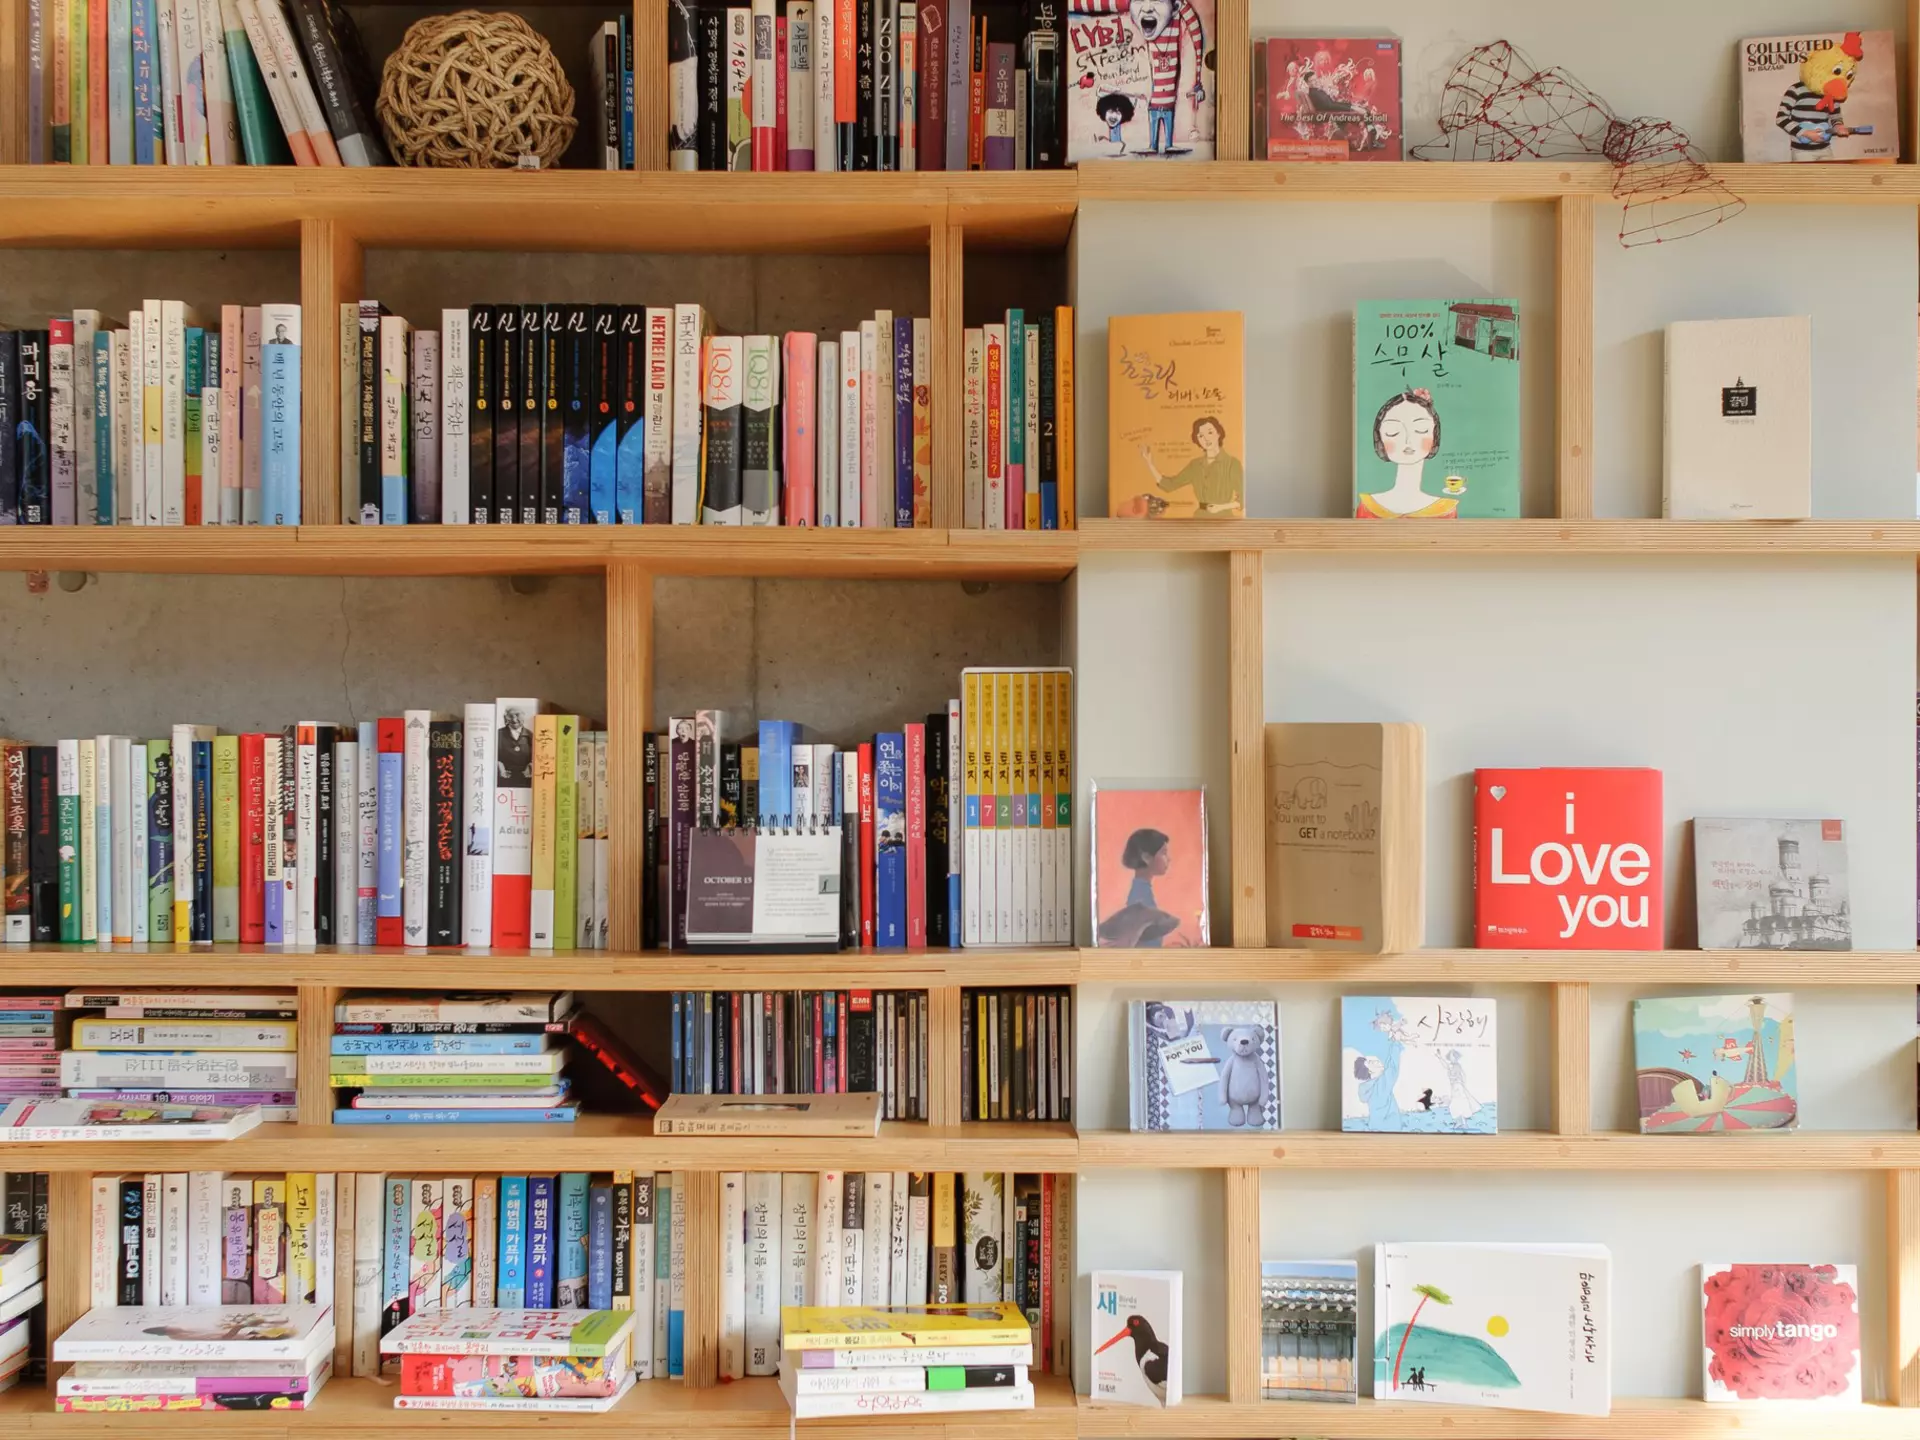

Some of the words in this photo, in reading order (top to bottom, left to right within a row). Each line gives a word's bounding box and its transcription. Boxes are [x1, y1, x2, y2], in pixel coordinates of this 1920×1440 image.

[880, 18, 892, 64] ZOO
[1747, 38, 1834, 55] COLLECTED
[1747, 51, 1809, 67] SOUNDS
[996, 69, 1009, 106] 오만과
[996, 110, 1009, 134] 편견
[1280, 113, 1293, 122] The
[1296, 113, 1314, 122] Best
[1316, 113, 1326, 122] Of
[1328, 113, 1360, 122] Andreas
[1363, 113, 1388, 122] Scholl
[472, 312, 491, 332] 신
[497, 312, 516, 332] 신
[522, 312, 541, 332] 신
[544, 312, 563, 332] 신
[567, 312, 586, 332] 신
[595, 314, 614, 334] 신
[622, 313, 641, 333] 신
[679, 312, 696, 355] 퀴즈쇼
[1385, 322, 1434, 339] 100%
[271, 352, 284, 364] 백
[968, 347, 979, 374] 우리는
[1370, 343, 1415, 377] 스무
[1421, 340, 1449, 377] 살
[271, 368, 284, 381] 년
[447, 364, 464, 394] 책은
[711, 345, 733, 403] 1Q84
[748, 346, 770, 403] 1Q84
[271, 383, 285, 423] 동안의
[416, 409, 434, 441] 살인
[447, 396, 464, 437] 죽었다
[271, 426, 284, 454] 고독
[968, 419, 979, 448] 라디오
[968, 450, 979, 469] 스타
[472, 736, 486, 761] 담배
[879, 740, 903, 760] 연을
[472, 765, 485, 788] 가게
[878, 760, 902, 777] 쫓는
[967, 750, 979, 784] 토지
[983, 750, 995, 784] 토지
[999, 750, 1011, 784] 토지
[1013, 750, 1025, 784] 토지
[1028, 750, 1041, 784] 토지
[1043, 750, 1055, 784] 토지
[1057, 750, 1070, 784] 토지
[320, 777, 330, 793] 나비
[860, 773, 872, 803] 싸이보그
[880, 775, 903, 793] 아이
[471, 790, 485, 817] 성자
[497, 789, 530, 824] 아듀
[677, 783, 690, 812] 심리학
[267, 798, 277, 841] 지속가능한
[861, 804, 872, 823] 그녀
[969, 803, 976, 818] 1
[983, 803, 992, 818] 7
[1000, 803, 1009, 818] 2
[1015, 803, 1024, 818] 3
[1030, 803, 1038, 818] 4
[1045, 803, 1053, 818] 5
[1059, 803, 1068, 818] 6
[1275, 812, 1290, 824] You
[1292, 813, 1314, 824] want
[1315, 813, 1327, 824] to
[1565, 791, 1575, 835] i
[498, 825, 530, 836] Adieu
[1299, 827, 1318, 839] GET
[1319, 830, 1325, 839] a
[1326, 827, 1376, 840] notebook?
[1491, 827, 1651, 887] Love
[703, 877, 742, 885] OCTOBER
[1557, 893, 1649, 939] you
[851, 996, 870, 1005] EMI
[213, 1009, 246, 1018] Emotions
[1416, 1003, 1490, 1042] 사랑해
[1184, 1042, 1204, 1055] YOU
[125, 1058, 165, 1073] 111선
[167, 1058, 240, 1073] 한국명수필
[223, 1073, 262, 1083] 읽어야
[190, 1094, 215, 1104] 이야기
[567, 1186, 585, 1209] 가족
[617, 1188, 629, 1216] 행복한
[506, 1199, 521, 1231] 해변의
[533, 1199, 548, 1231] 해변의
[671, 1191, 685, 1240] 머리청소
[754, 1202, 769, 1240] 장미의
[791, 1203, 807, 1241] 장미의
[228, 1211, 246, 1266] 몽유병자들
[260, 1211, 278, 1266] 몽유병자들
[615, 1216, 630, 1249] 가족의
[506, 1233, 521, 1266] 카프카
[533, 1233, 548, 1266] 카프카
[754, 1243, 769, 1267] 이름
[791, 1243, 807, 1268] 이름
[671, 1243, 685, 1293] 마음청소
[844, 1233, 858, 1296] 외딴방
[1096, 1291, 1117, 1315] 새
[1118, 1295, 1137, 1304] Birds
[1729, 1324, 1775, 1341] simply
[1776, 1320, 1838, 1342] tango
